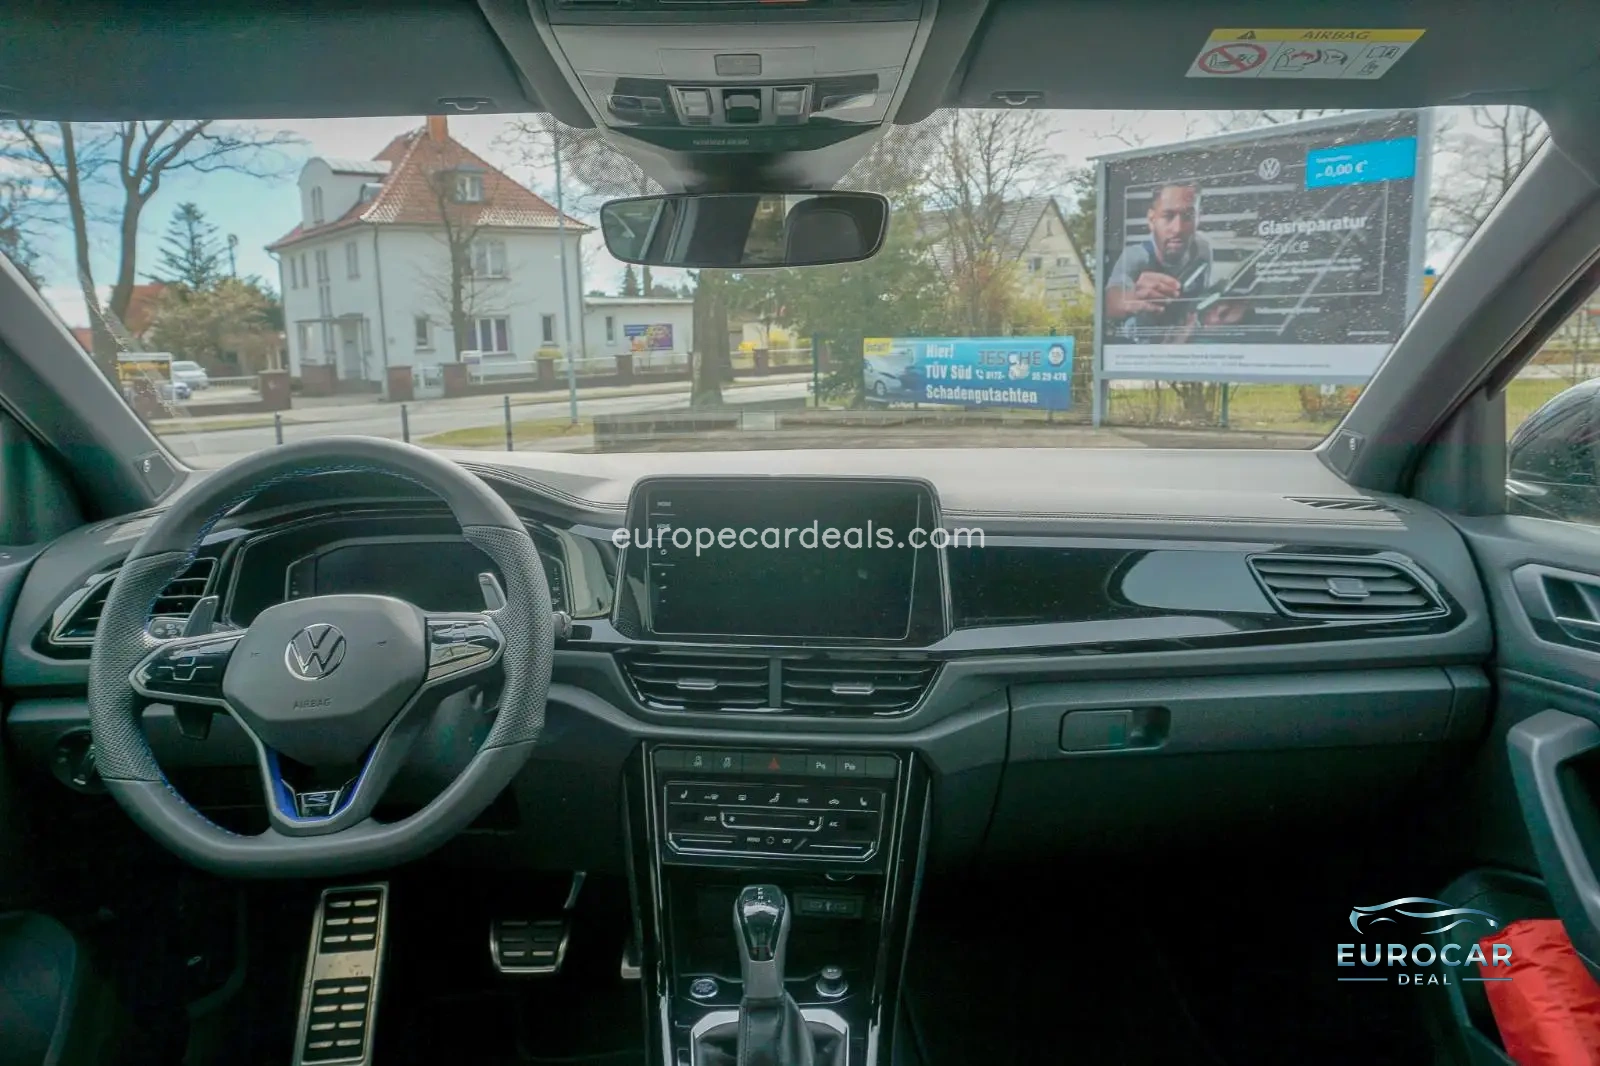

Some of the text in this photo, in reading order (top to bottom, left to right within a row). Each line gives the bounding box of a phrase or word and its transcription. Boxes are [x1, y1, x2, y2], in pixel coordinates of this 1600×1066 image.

[1302, 30, 1372, 41] AIRBAG
[1258, 215, 1368, 236] Glasreparatur
[926, 344, 954, 359] Hier!
[925, 361, 972, 380] TÜV Süd
[926, 384, 1038, 404] Schadengutachten
[293, 698, 332, 710] AIRBAG
